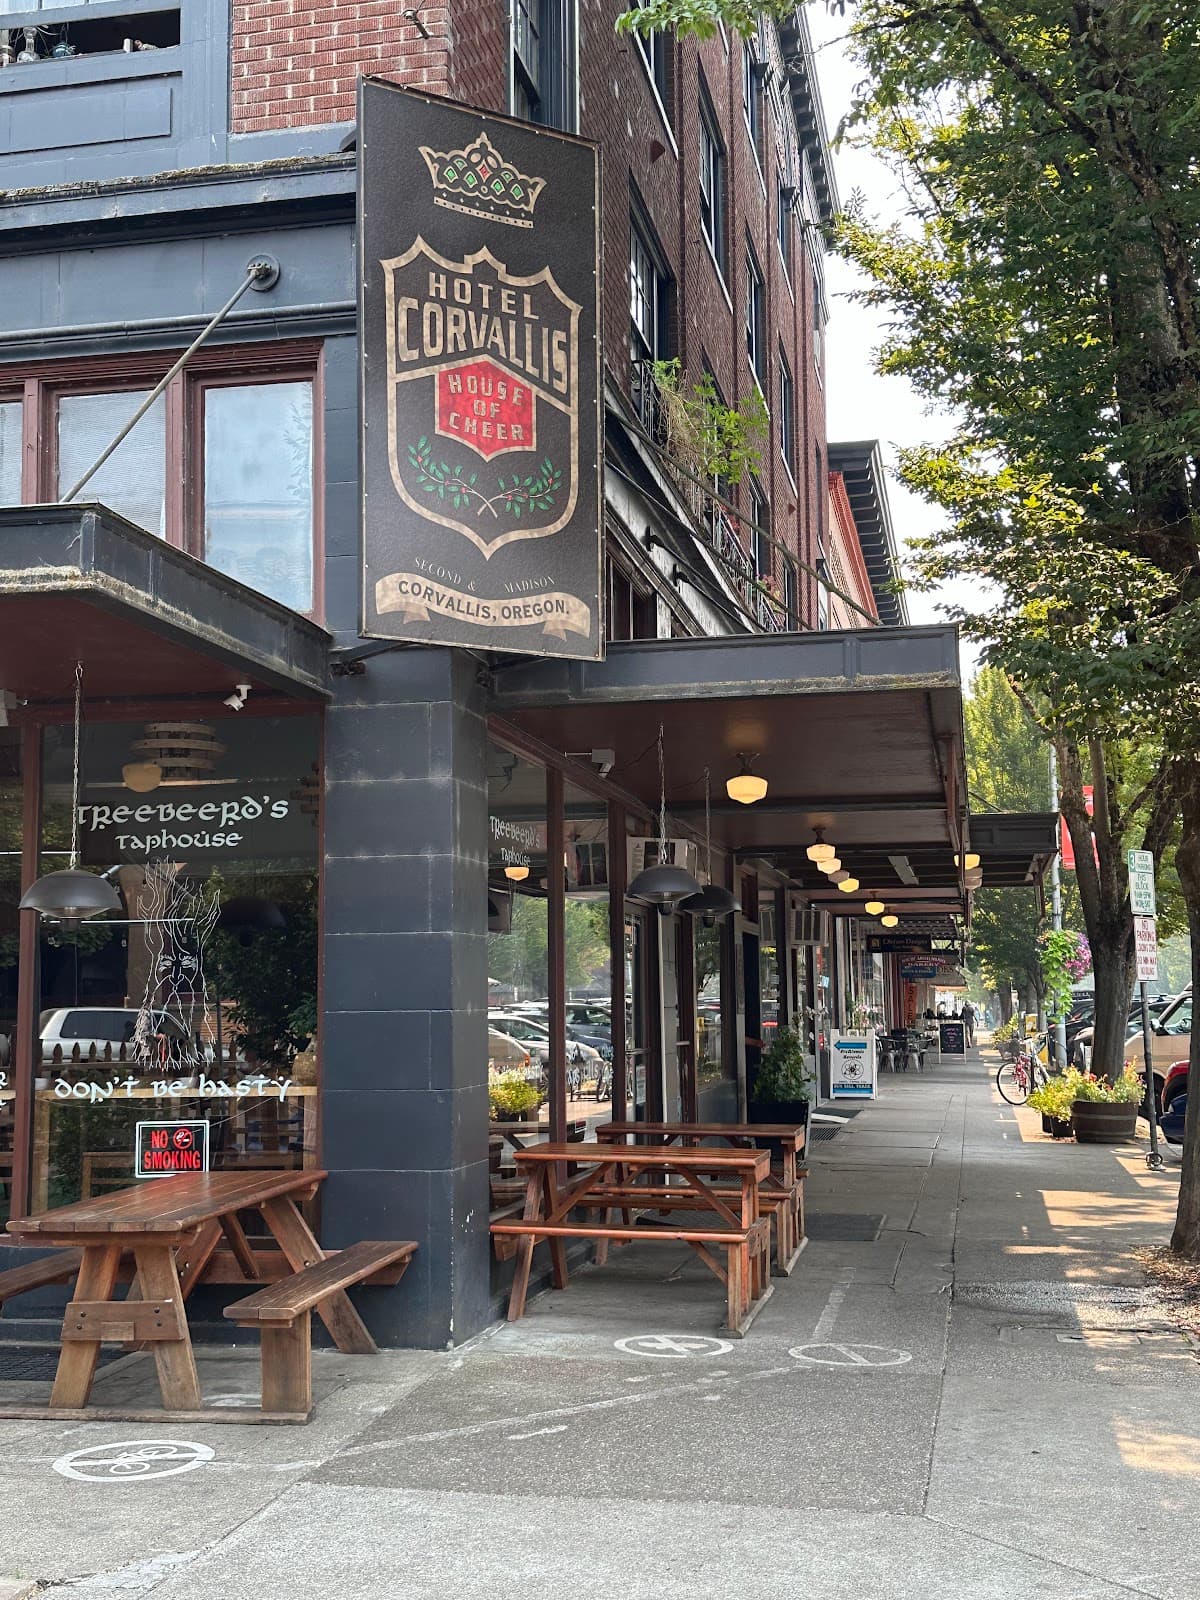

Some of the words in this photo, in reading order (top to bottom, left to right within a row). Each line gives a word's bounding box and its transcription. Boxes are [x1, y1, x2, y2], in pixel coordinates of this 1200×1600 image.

[428, 271, 540, 320] HOTEL
[398, 296, 568, 395] CORVALLIS
[447, 374, 525, 406] HOUSE
[473, 399, 501, 419] OF
[449, 412, 525, 441] CHEER
[414, 557, 462, 586] SECOND
[467, 580, 478, 593] &
[503, 574, 556, 595] MADISON
[398, 579, 497, 623] CORVALLIS,
[501, 600, 570, 621] OREGON.
[1136, 930, 1155, 942] PARKING
[1141, 919, 1149, 930] NO
[151, 1129, 169, 1149] NO
[143, 1150, 201, 1170] SMOKING
